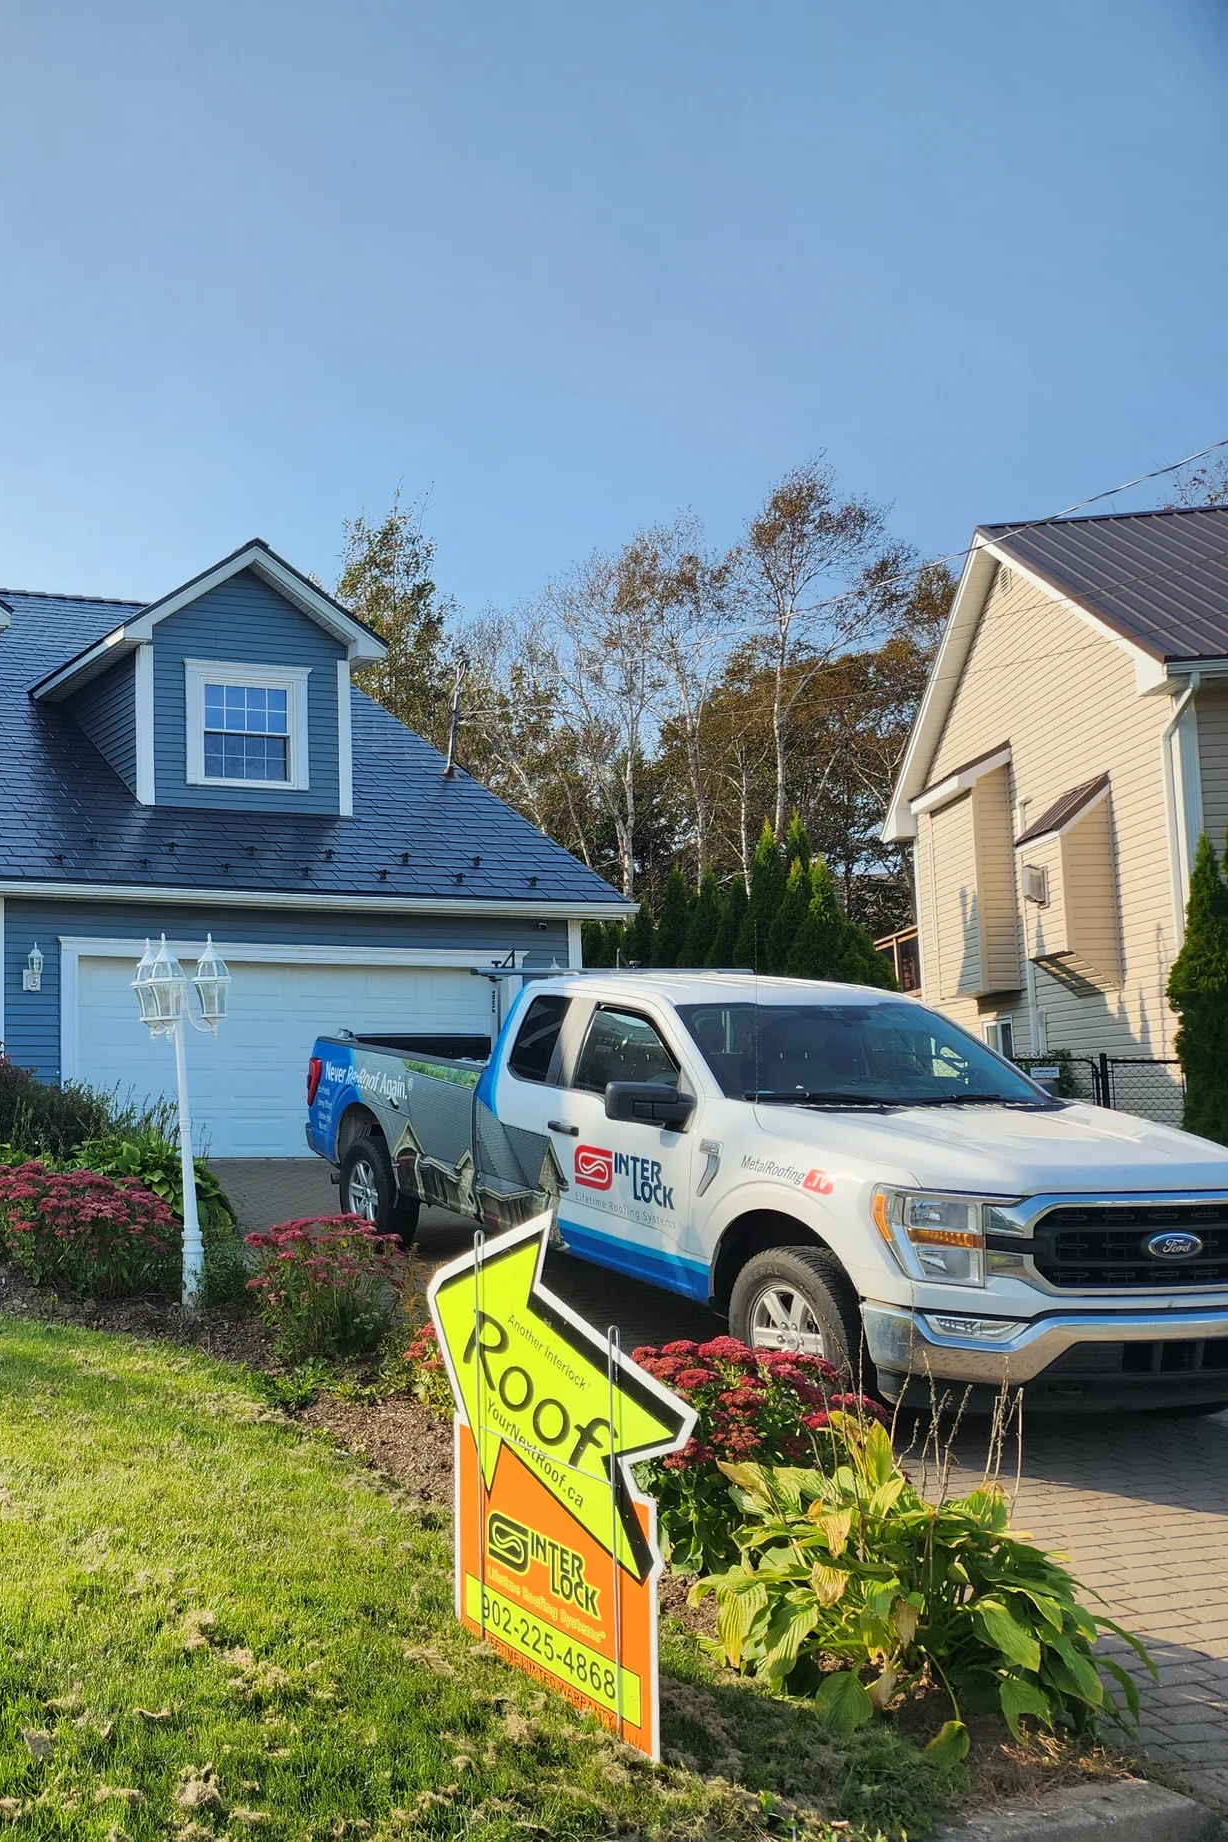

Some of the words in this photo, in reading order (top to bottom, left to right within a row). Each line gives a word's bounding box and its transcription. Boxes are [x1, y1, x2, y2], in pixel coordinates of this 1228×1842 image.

[325, 1061, 347, 1084] Never
[614, 1152, 662, 1188] INTER
[575, 1191, 607, 1210] Lifetime
[608, 1201, 640, 1221] Roofing
[633, 1180, 675, 1211] LOCK
[1162, 1238, 1192, 1253] Ford
[507, 1314, 544, 1353] Another
[462, 1308, 620, 1469] Roof
[530, 1532, 585, 1584] INTER
[551, 1573, 600, 1620] LOCK
[483, 1593, 616, 1701] 902-225-4868
